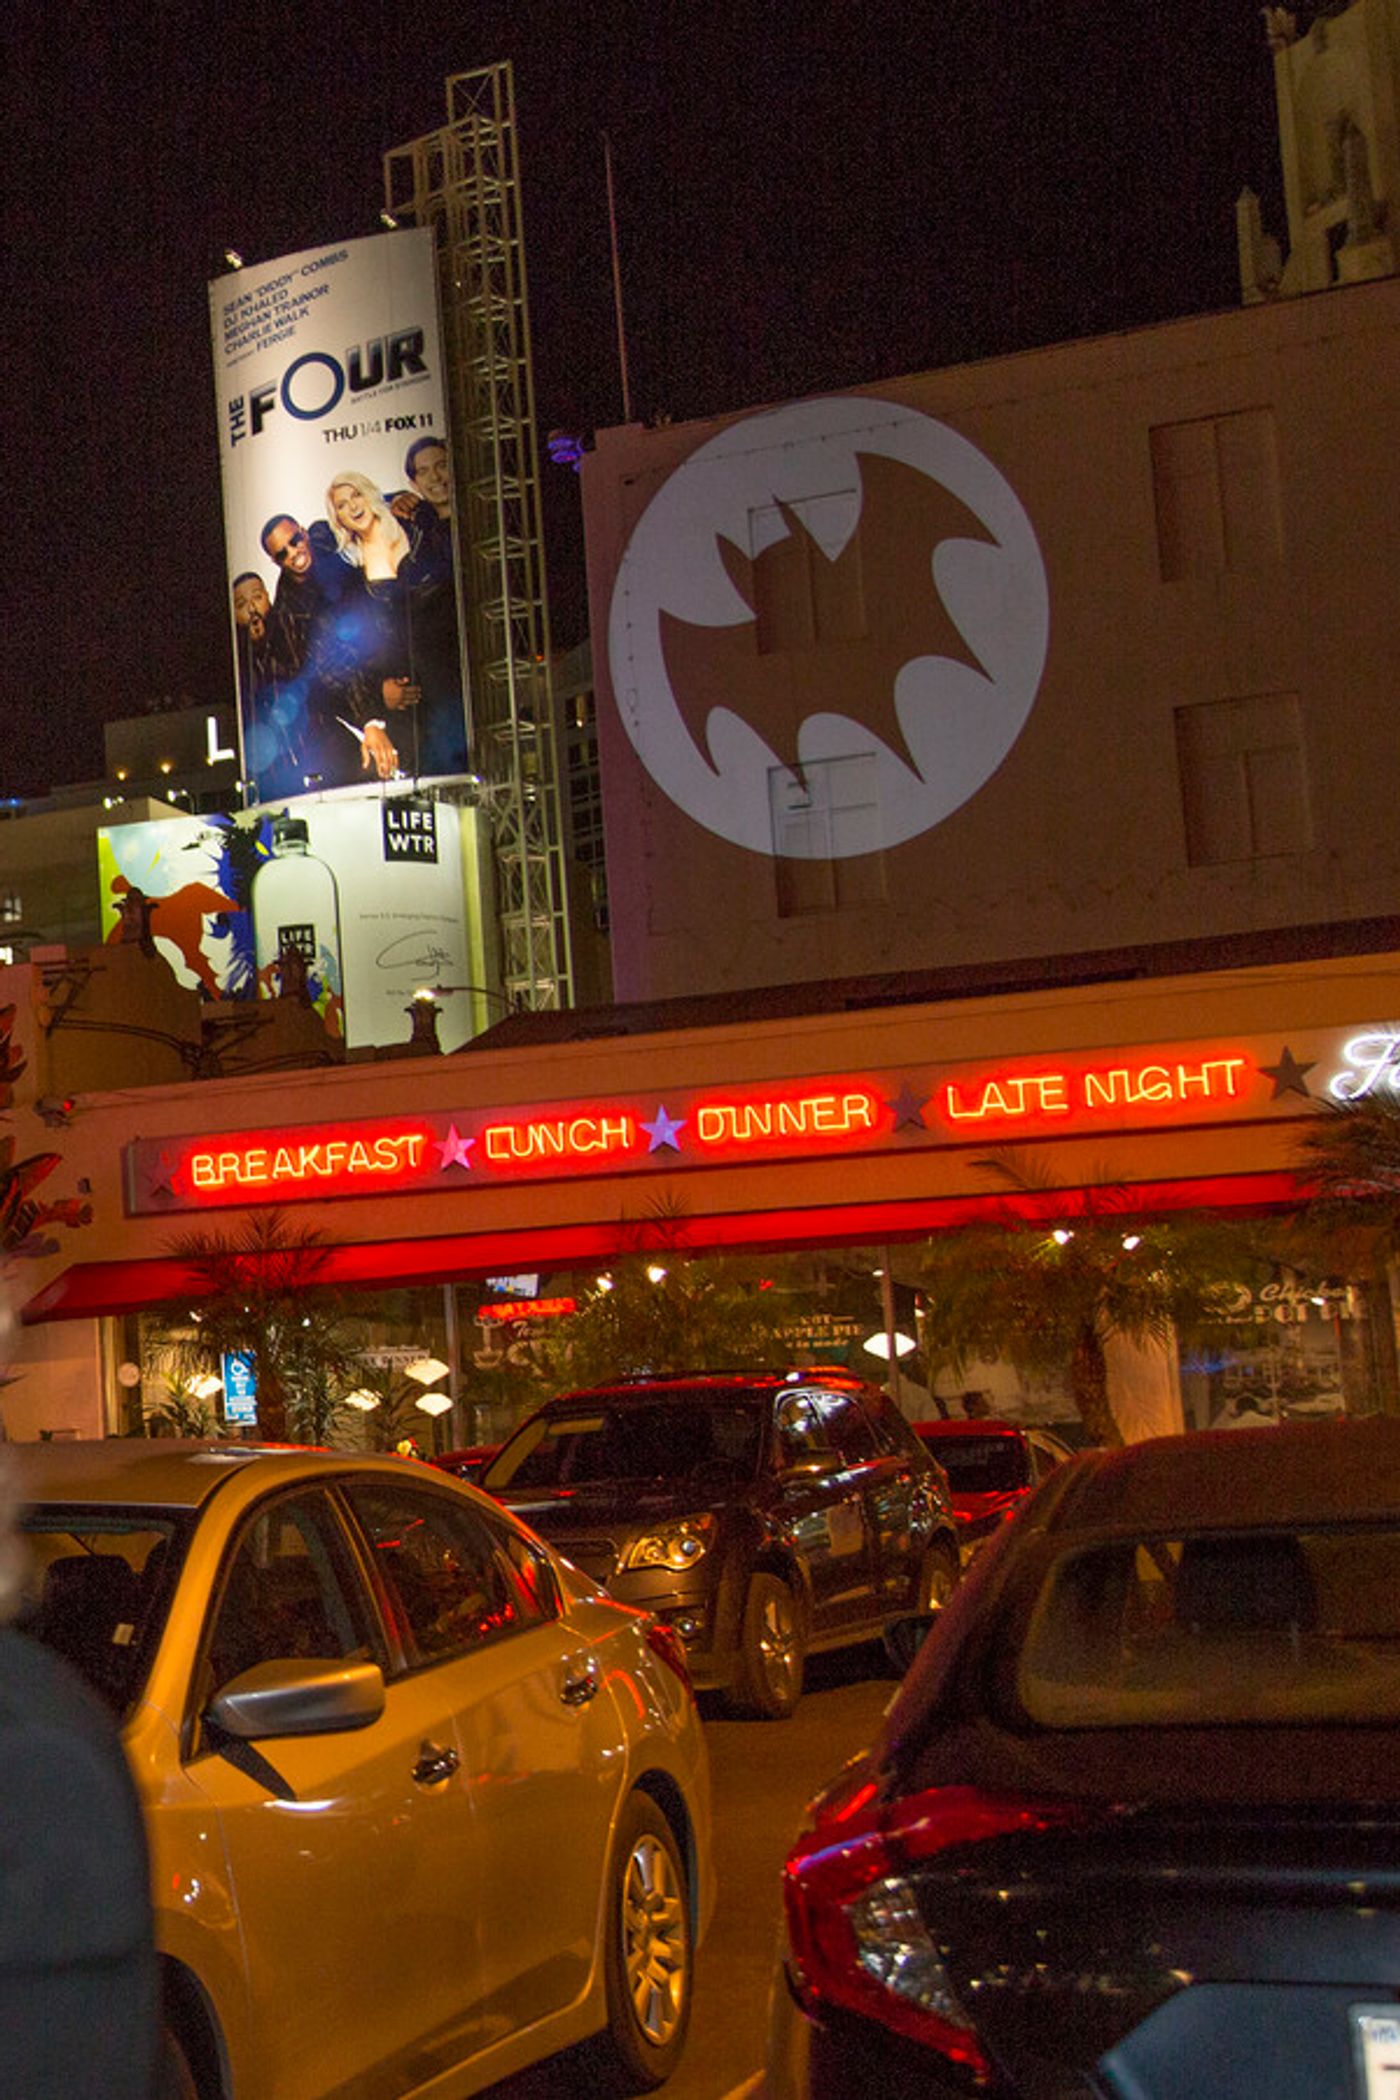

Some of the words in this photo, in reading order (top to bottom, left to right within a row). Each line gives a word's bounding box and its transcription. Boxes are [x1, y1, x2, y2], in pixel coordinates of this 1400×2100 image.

[240, 289, 288, 317] KHALED
[273, 284, 330, 314] TRAINOR
[274, 307, 309, 328] WALK
[229, 395, 246, 447] THE
[249, 325, 428, 437] FOUR
[323, 425, 359, 443] THU
[384, 415, 417, 433] FOX
[418, 413, 434, 428] 11
[387, 810, 433, 830] LIFE
[387, 833, 435, 853] WTR
[191, 1133, 424, 1187] BREAKFAST
[486, 1116, 630, 1160] LUNCH
[697, 1093, 872, 1141] DINNER
[947, 1081, 1070, 1118] LATE
[1085, 1059, 1245, 1107] NIGHT
